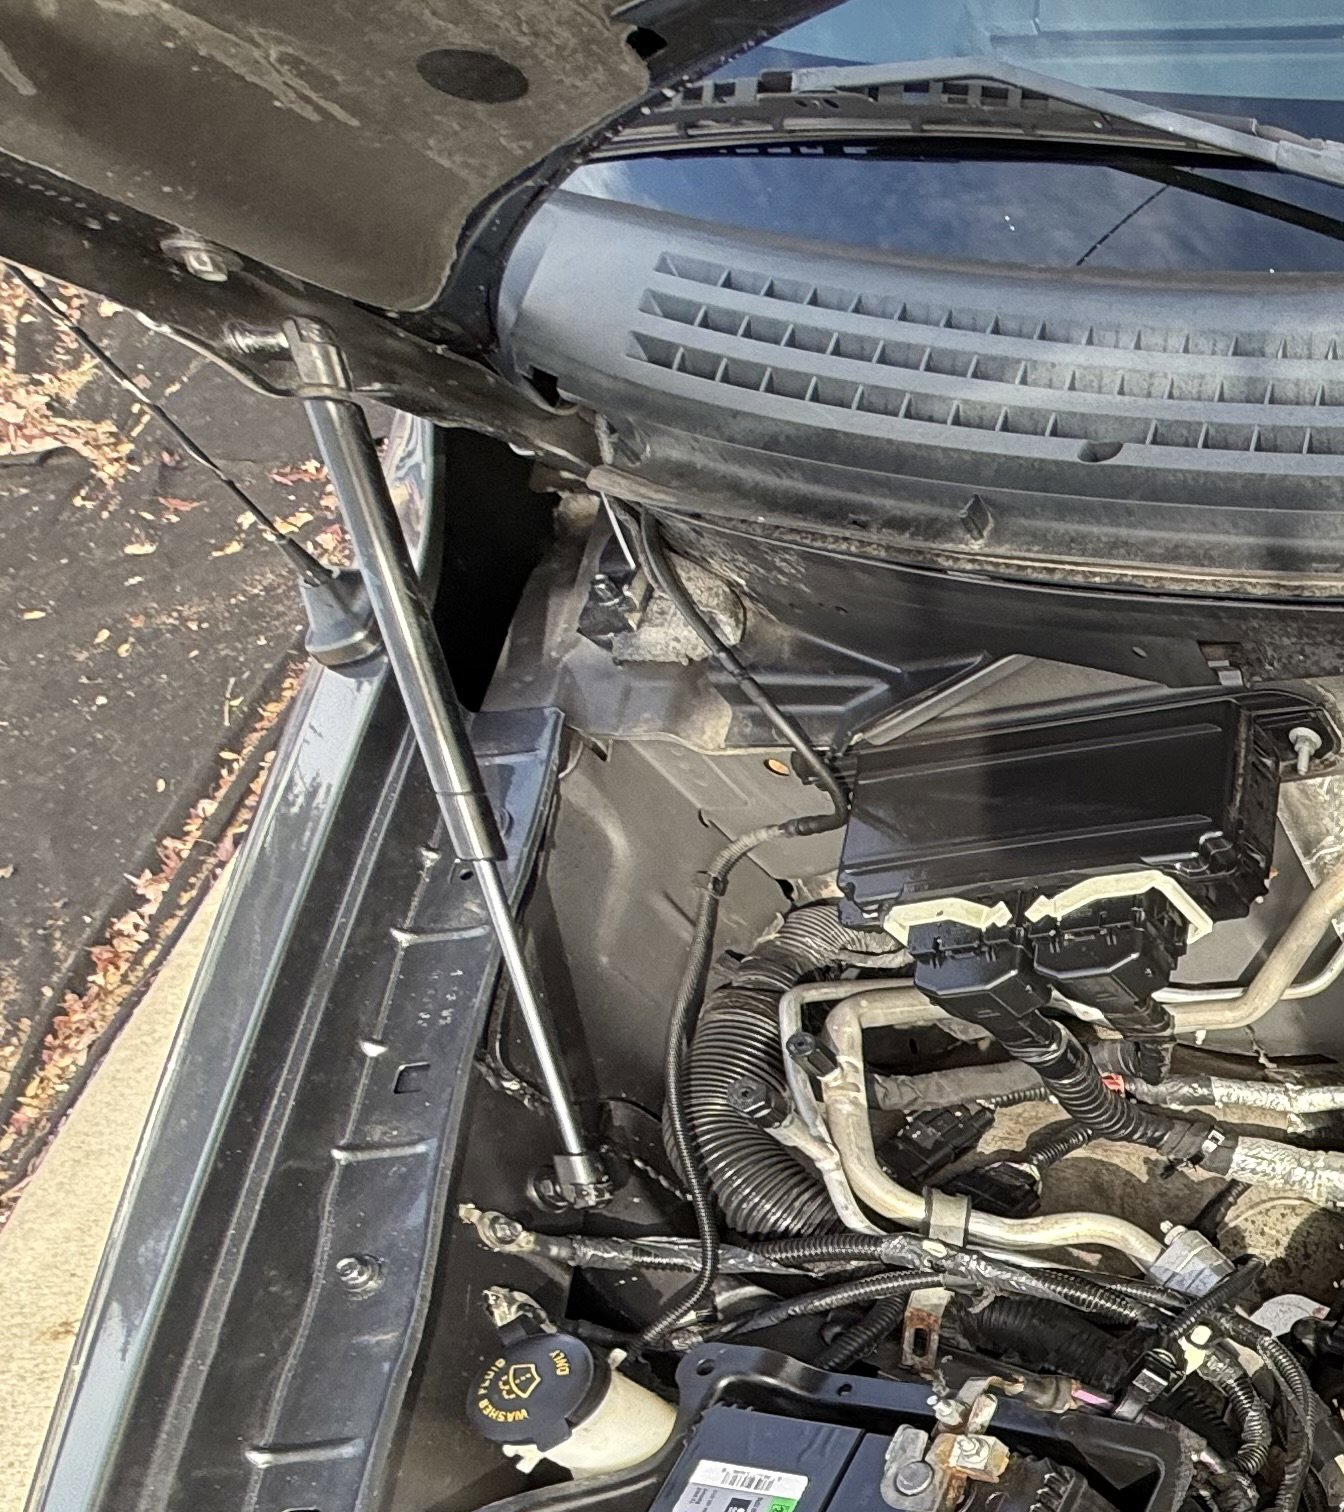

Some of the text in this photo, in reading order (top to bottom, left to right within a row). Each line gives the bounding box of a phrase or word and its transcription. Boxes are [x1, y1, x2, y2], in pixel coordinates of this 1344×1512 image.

[477, 1349, 570, 1422] WASHER FLUID ONLY
